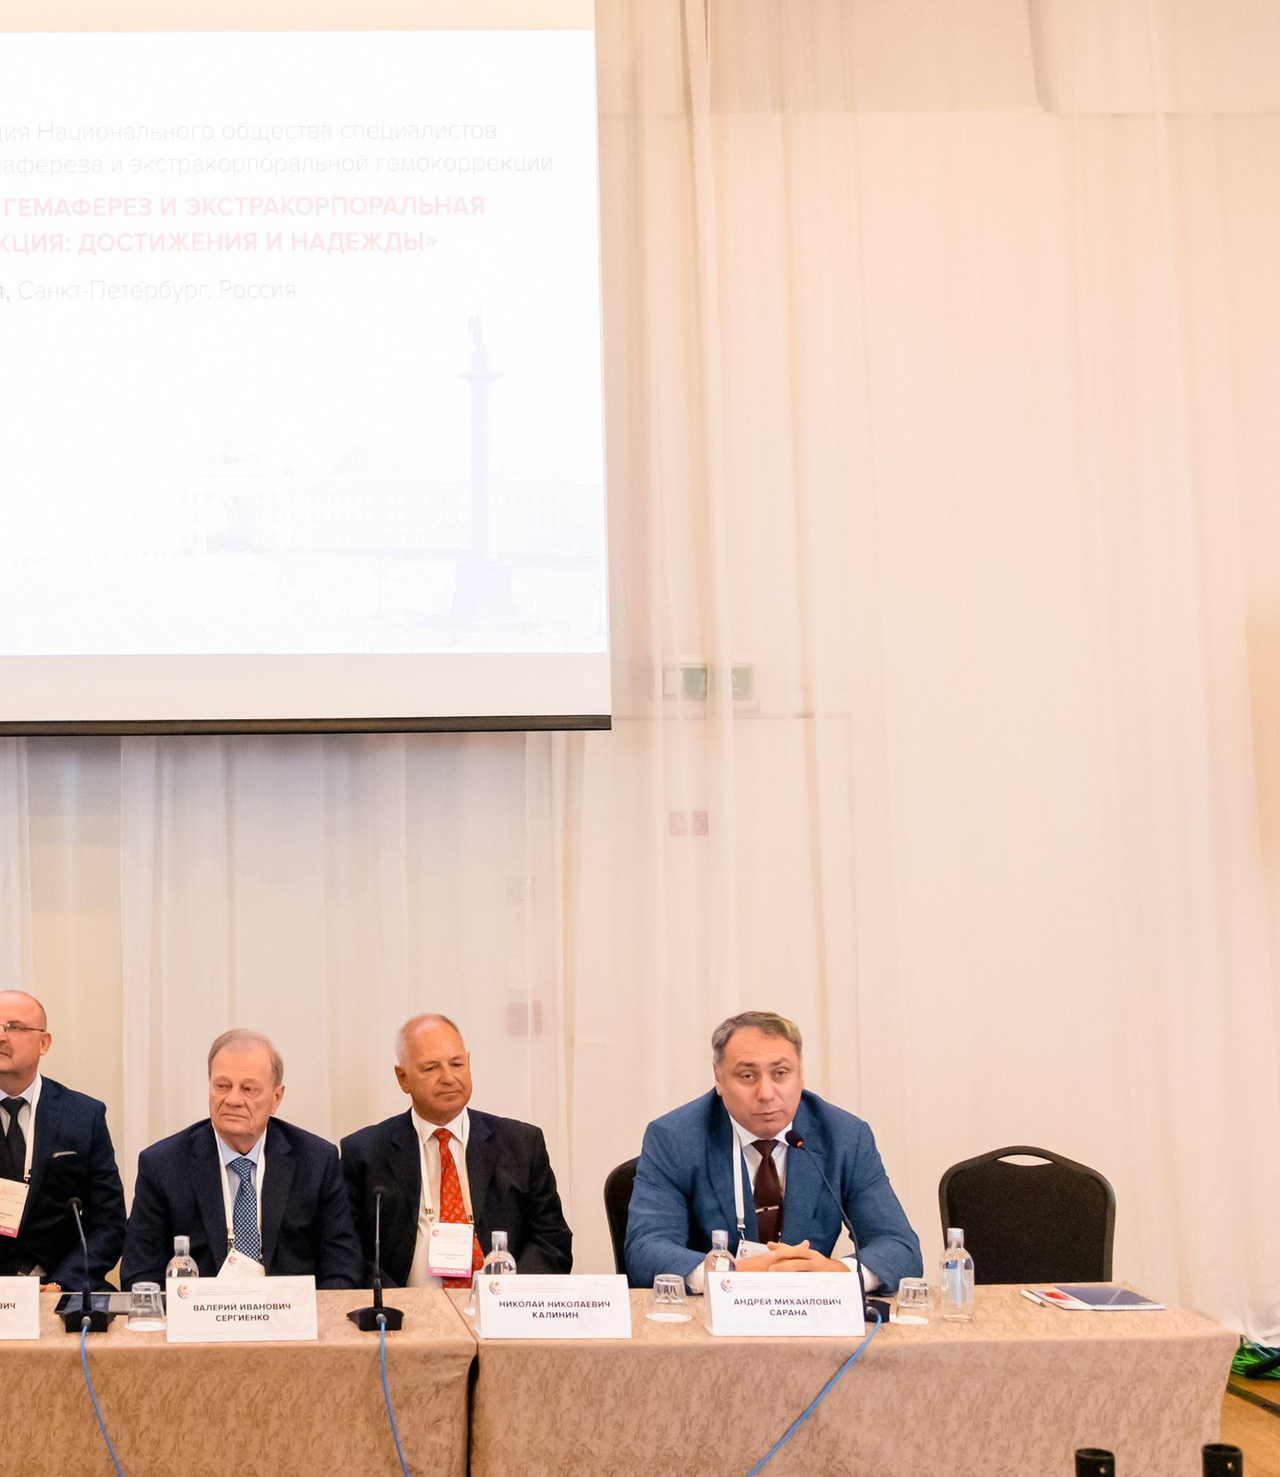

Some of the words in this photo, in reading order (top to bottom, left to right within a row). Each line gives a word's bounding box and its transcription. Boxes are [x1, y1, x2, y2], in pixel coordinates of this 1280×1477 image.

[38, 122, 214, 144] Национального
[222, 121, 332, 144] общества
[340, 123, 497, 143] специалистов
[111, 158, 123, 173] и
[131, 154, 368, 177] экстракорпоральной
[376, 156, 553, 176] гемокоррекции
[4, 197, 152, 217] ГЕМАФЕРЕЗ
[161, 197, 176, 216] И
[185, 196, 485, 216] ЭКСТРАКОРПОРАЛЬНАЯ
[78, 232, 258, 255] ДОСТИЖЕНИЯ
[266, 232, 282, 251] И
[292, 232, 437, 254] НАДЕЖДЫ»
[18, 280, 212, 304] Санкт-Петербург,
[219, 280, 296, 298] Россия
[193, 1303, 237, 1311] ВАЛЕРИЙ
[240, 1303, 291, 1311] ИВАНОВИЧ
[499, 1300, 545, 1308] НИКОЛАЙ
[547, 1300, 611, 1308] НИКОЛАЕВИЧ
[733, 1297, 772, 1306] АНДРЕЙ
[774, 1297, 841, 1306] МИХАЙЛОВИЧ
[215, 1314, 270, 1322] СЕРГИЕНКО
[532, 1311, 579, 1319] КАЛИНИН
